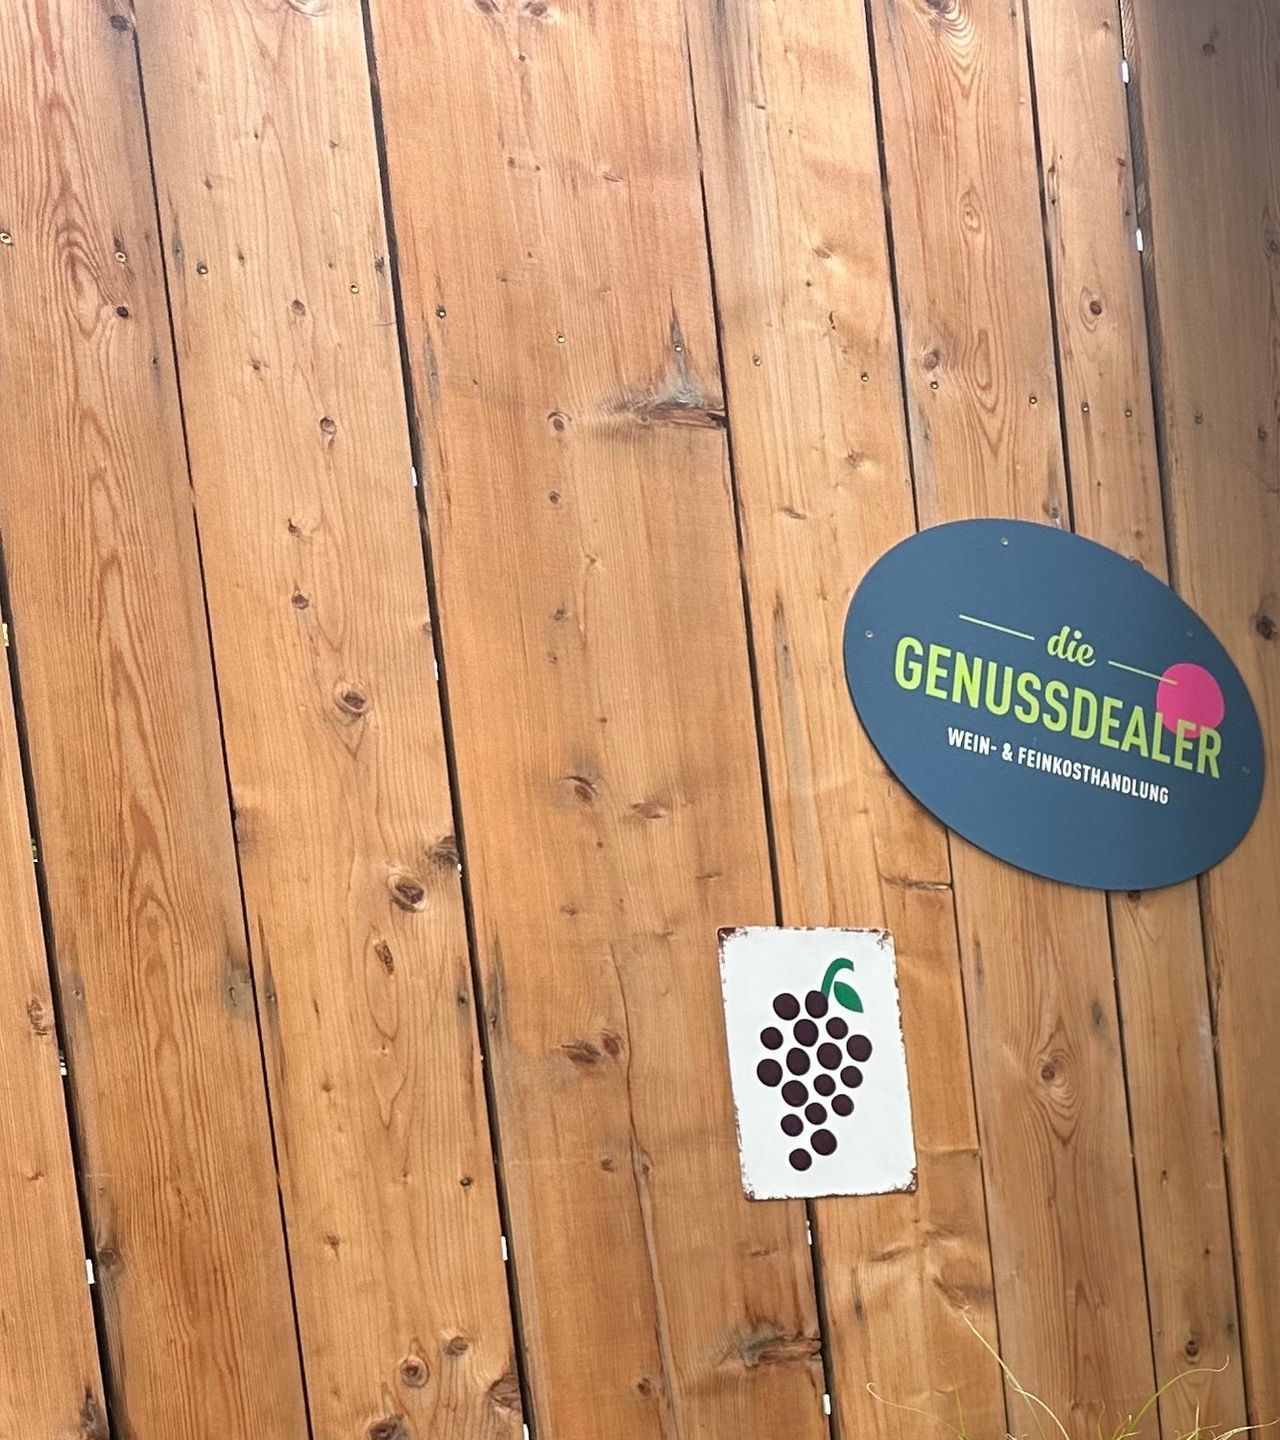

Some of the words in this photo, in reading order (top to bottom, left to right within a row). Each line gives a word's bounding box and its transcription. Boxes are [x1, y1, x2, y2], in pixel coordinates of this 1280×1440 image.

[1046, 625, 1096, 668] die
[894, 636, 1222, 778] GENUSSDEALER
[948, 727, 997, 755] WEIN-
[1001, 742, 1014, 762] &
[1018, 747, 1169, 804] FEINKOSTHANDLUNG
